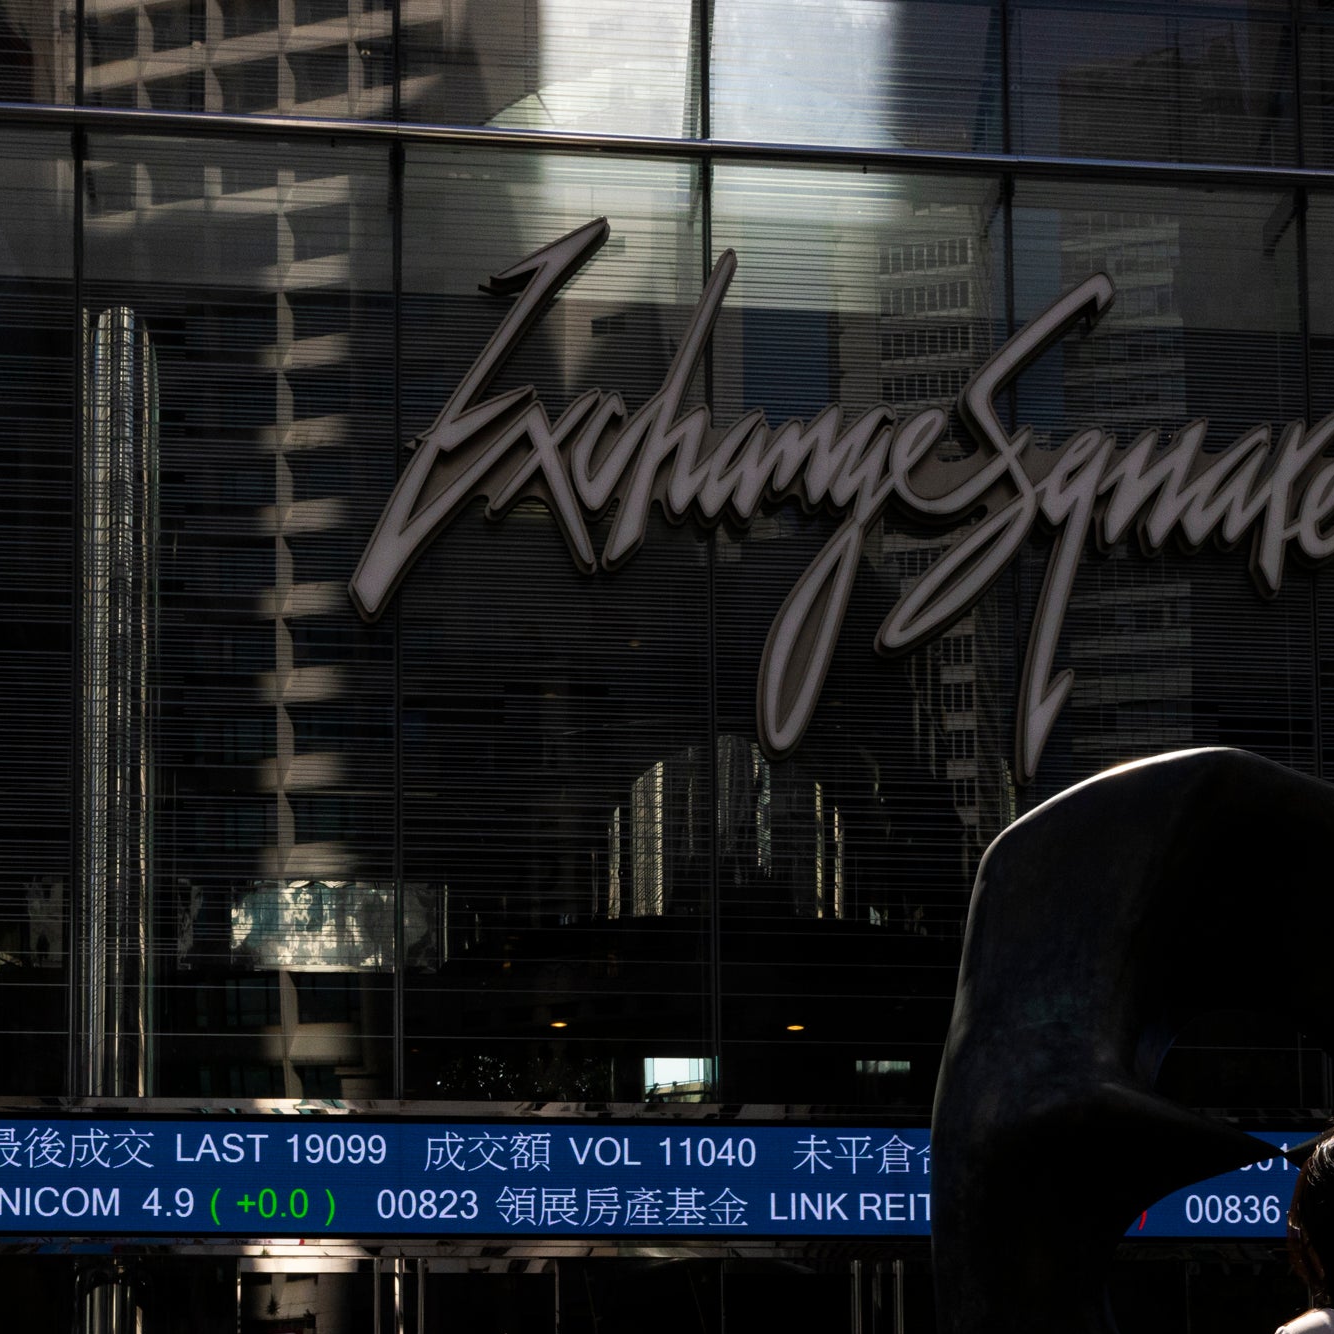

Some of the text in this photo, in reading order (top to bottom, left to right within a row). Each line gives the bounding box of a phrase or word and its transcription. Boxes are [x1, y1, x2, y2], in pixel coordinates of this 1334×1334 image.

[349, 216, 1002, 762] Exchange
[176, 1132, 269, 1163] LAST
[286, 1133, 387, 1165] 19099
[424, 1131, 552, 1172] 成交額
[568, 1136, 642, 1166] VOL
[659, 1137, 757, 1168] 11040
[142, 1187, 194, 1218] 4.9
[377, 1188, 479, 1220] 00823
[495, 1185, 749, 1227] 領展房產基金
[770, 1192, 849, 1221] LINK
[1185, 1194, 1281, 1224] 00836
